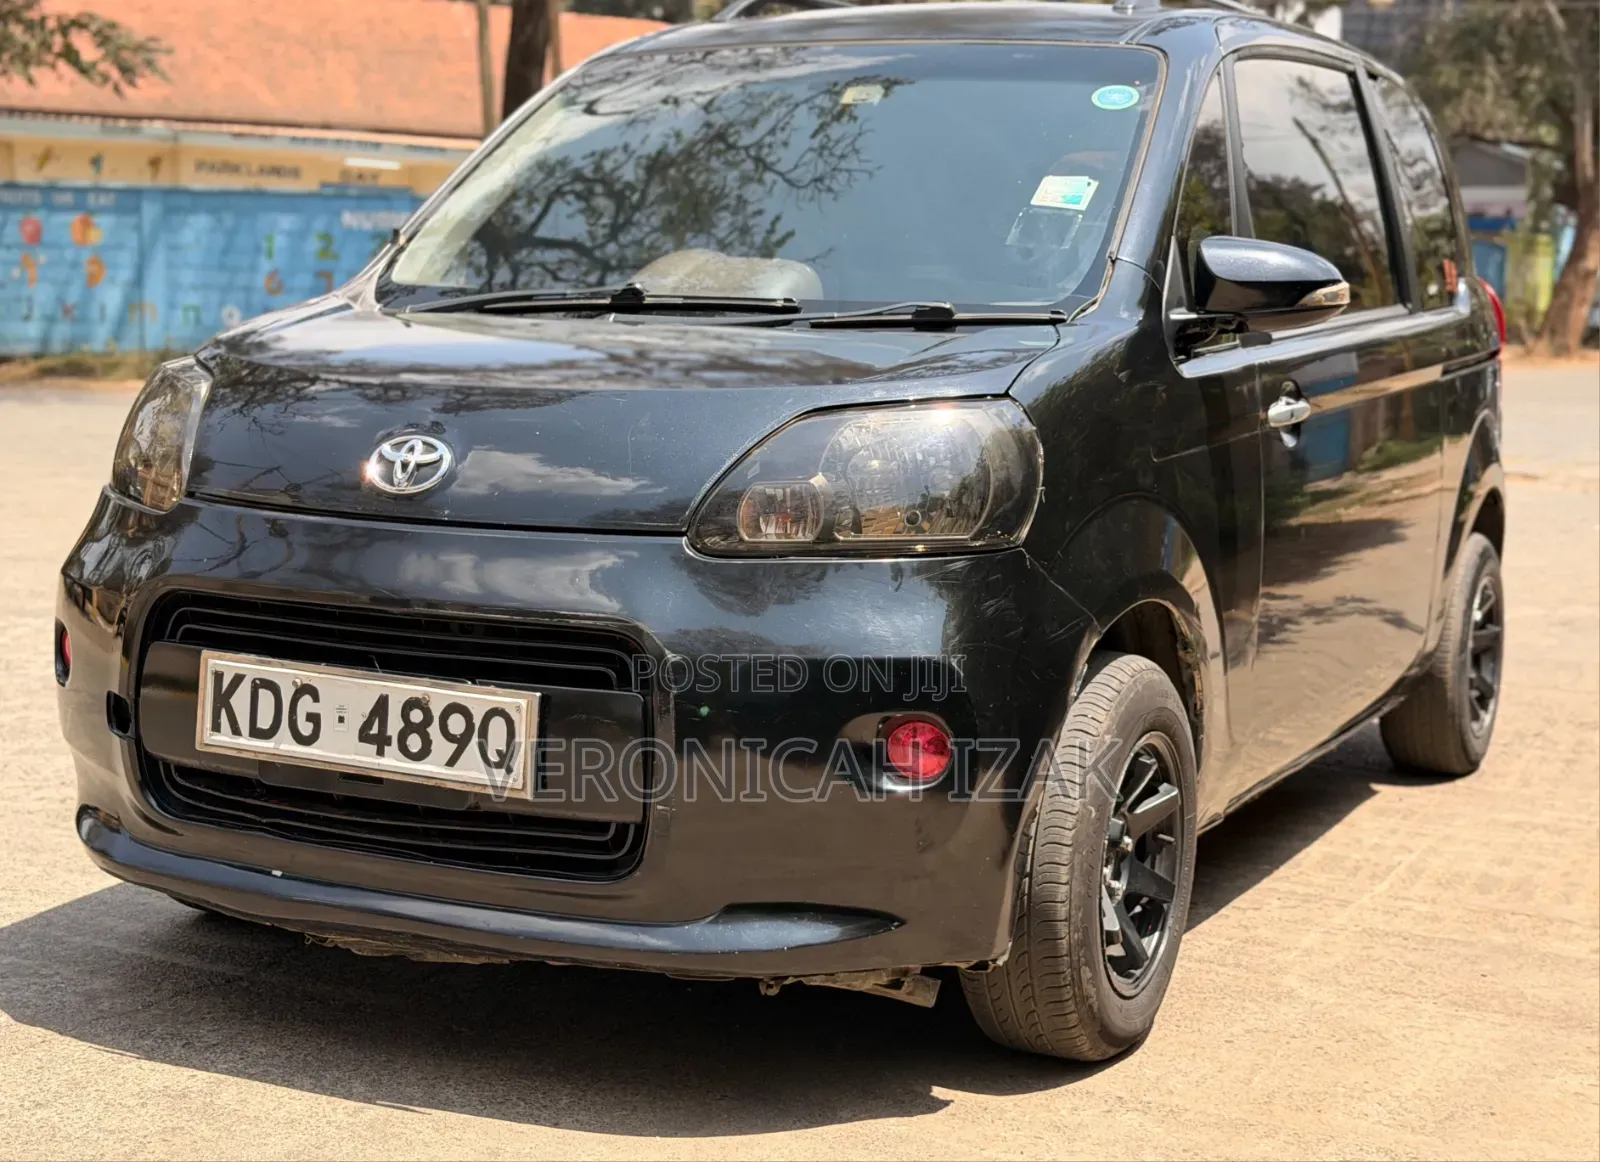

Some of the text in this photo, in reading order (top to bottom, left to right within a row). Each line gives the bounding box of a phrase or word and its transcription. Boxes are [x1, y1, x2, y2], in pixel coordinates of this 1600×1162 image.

[315, 232, 339, 259] 2
[264, 267, 285, 297] 6
[212, 670, 517, 776] KDG 489Q
